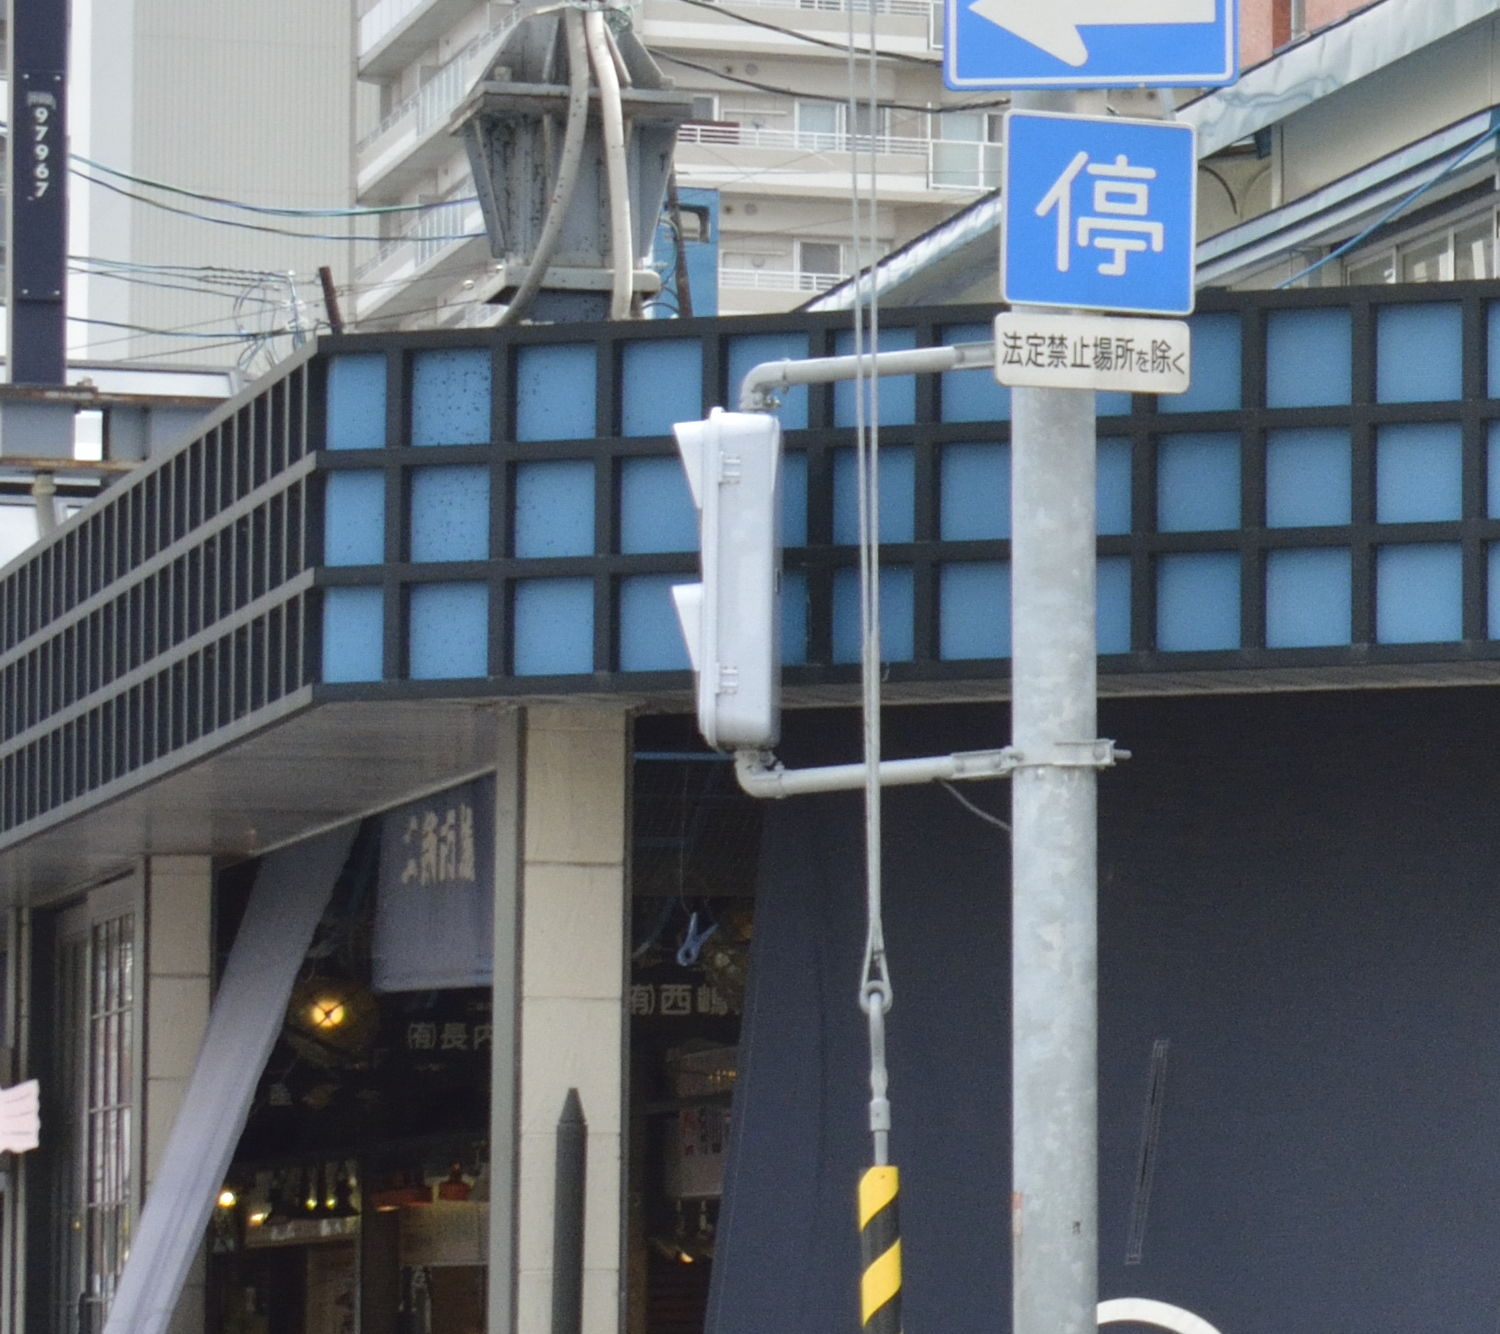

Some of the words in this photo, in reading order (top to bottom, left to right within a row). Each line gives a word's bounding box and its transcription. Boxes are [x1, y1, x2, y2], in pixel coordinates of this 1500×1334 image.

[33, 107, 50, 199] 97967
[1035, 151, 1165, 277] 停
[1002, 331, 1186, 375] 法定禁止場所を除く
